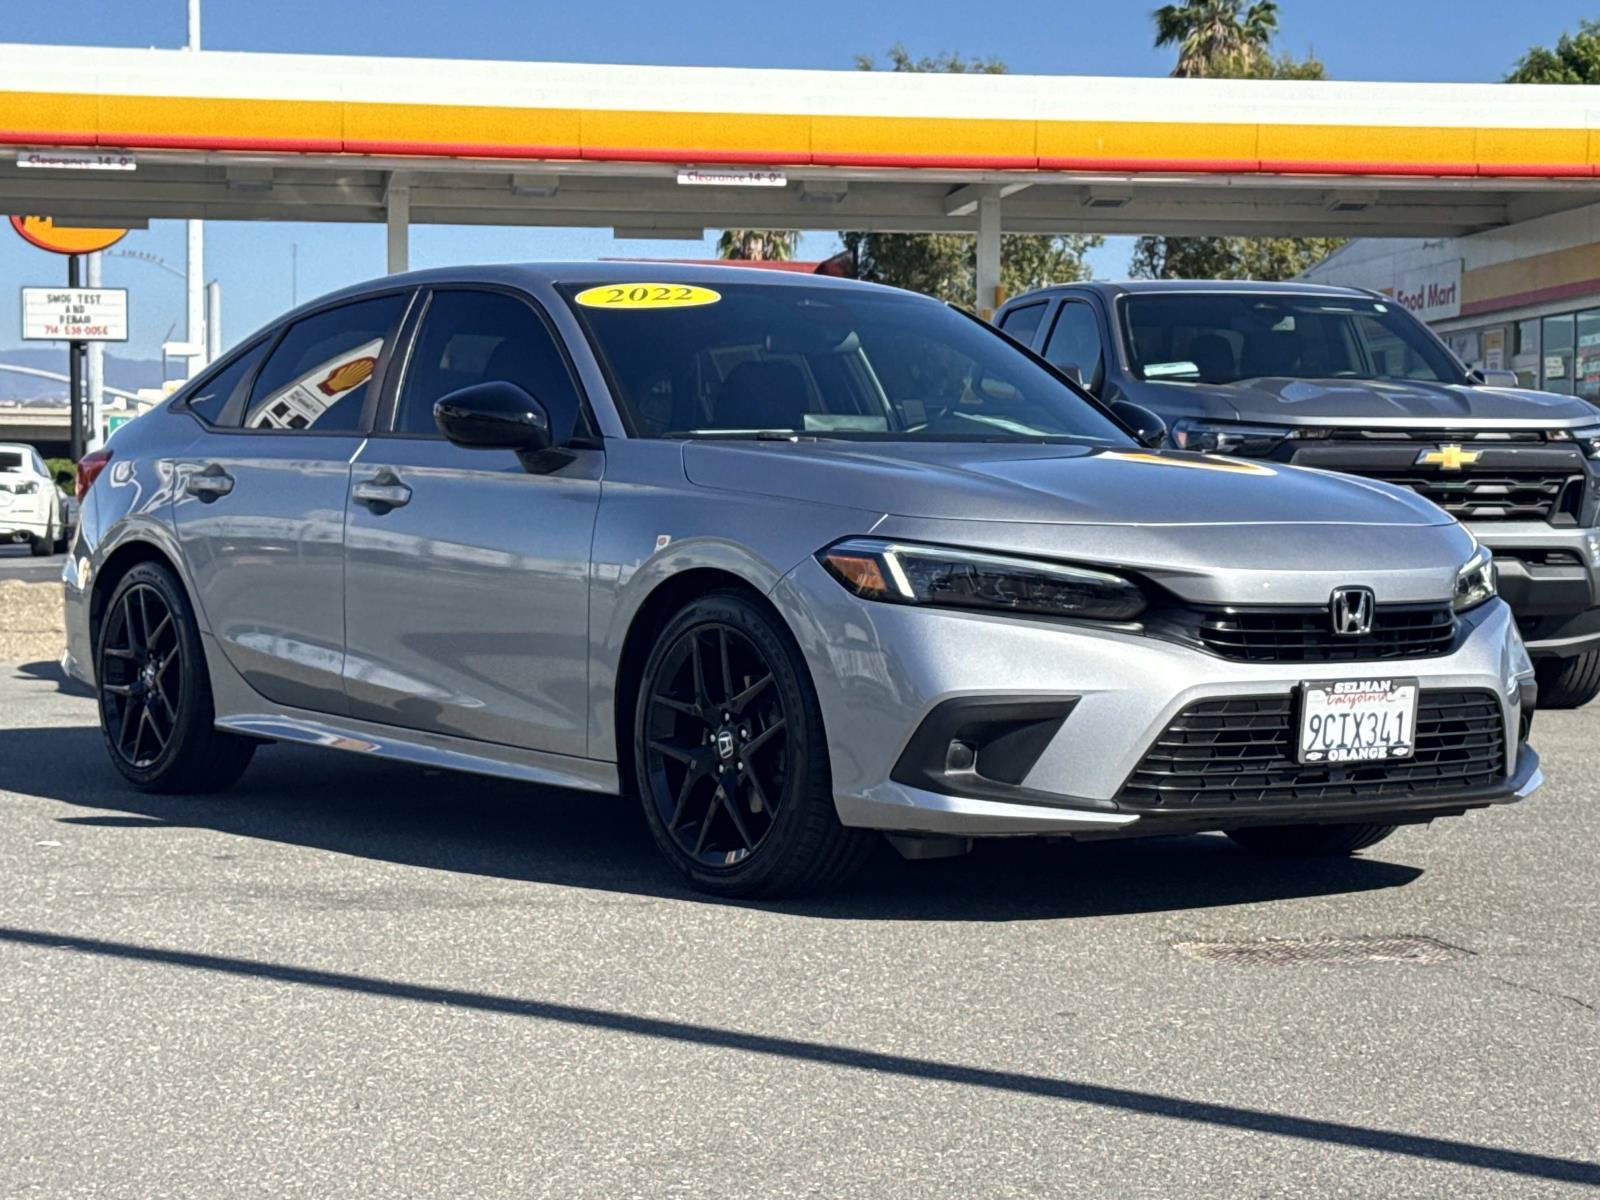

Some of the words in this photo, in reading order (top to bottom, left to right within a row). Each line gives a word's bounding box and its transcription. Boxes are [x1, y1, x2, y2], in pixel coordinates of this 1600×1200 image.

[687, 171, 746, 182] Clearance
[46, 293, 72, 304] SMOG
[77, 294, 102, 304] TEST
[605, 287, 694, 303] 2022
[1428, 281, 1456, 308] Mart
[1333, 680, 1392, 693] SELMAN
[1327, 746, 1388, 761] ORANGE
